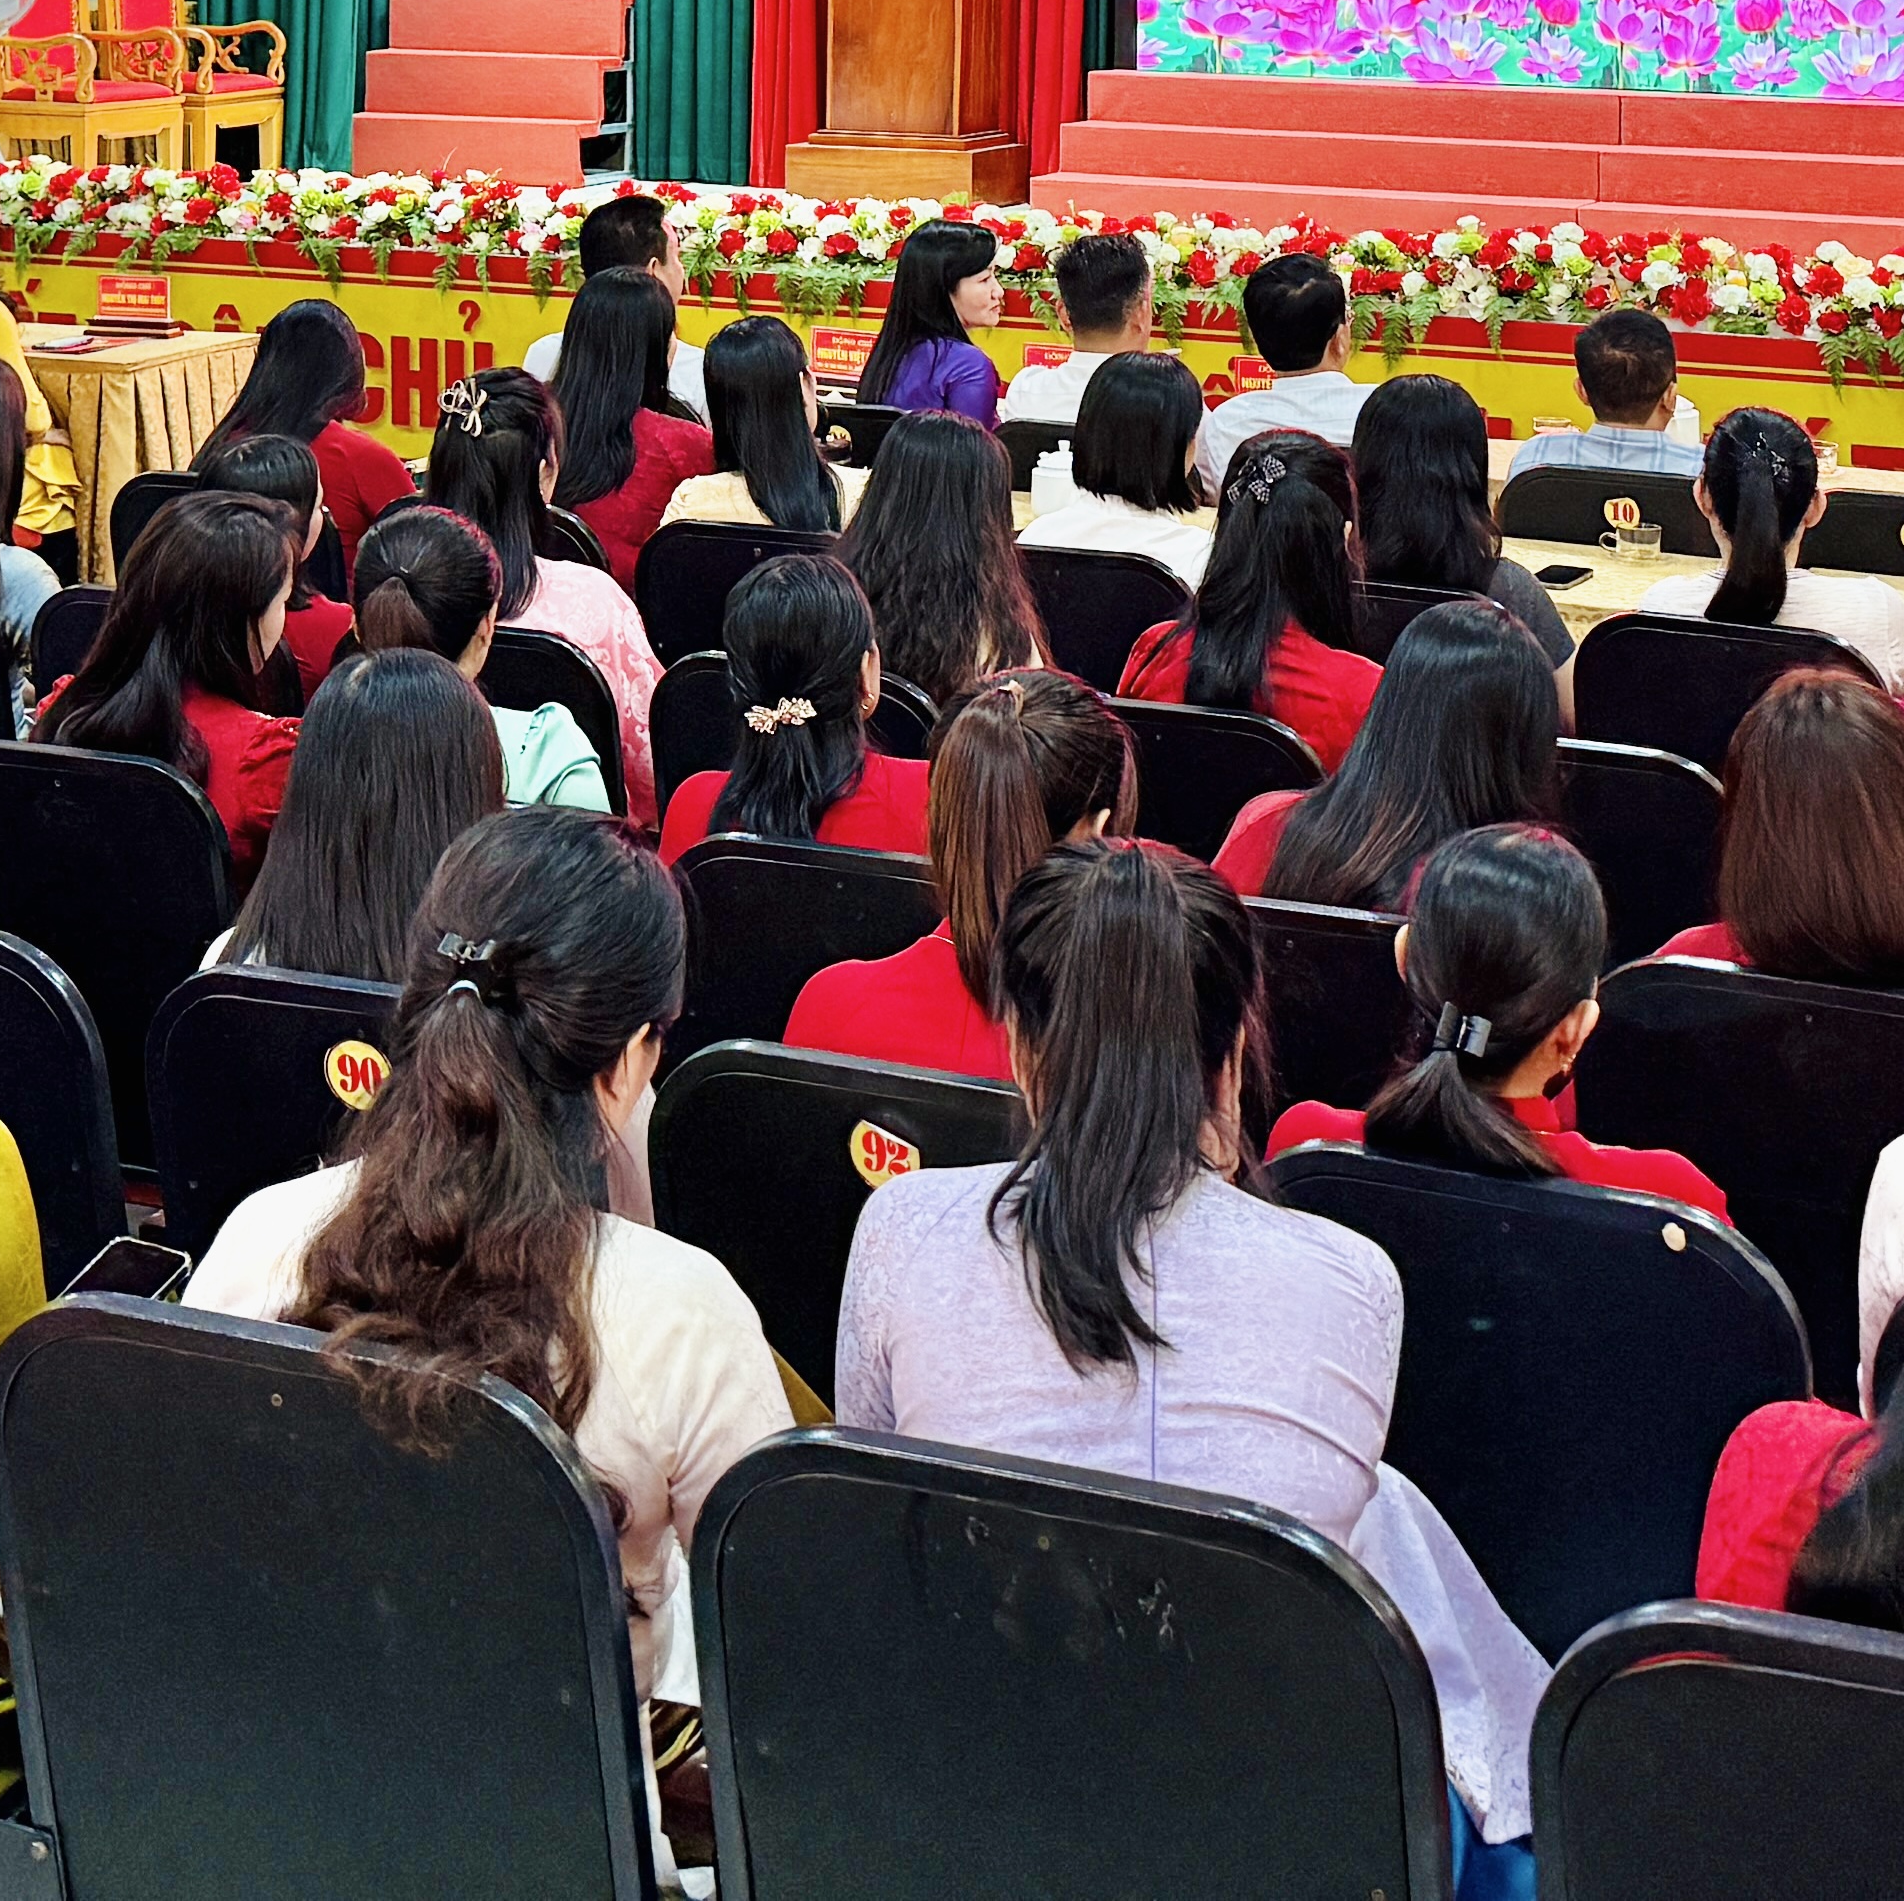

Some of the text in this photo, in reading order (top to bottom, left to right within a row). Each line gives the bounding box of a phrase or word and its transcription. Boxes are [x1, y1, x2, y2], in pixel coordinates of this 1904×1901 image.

[1610, 501, 1635, 524] 10
[336, 1052, 383, 1098] 90
[861, 1129, 911, 1176] 92
